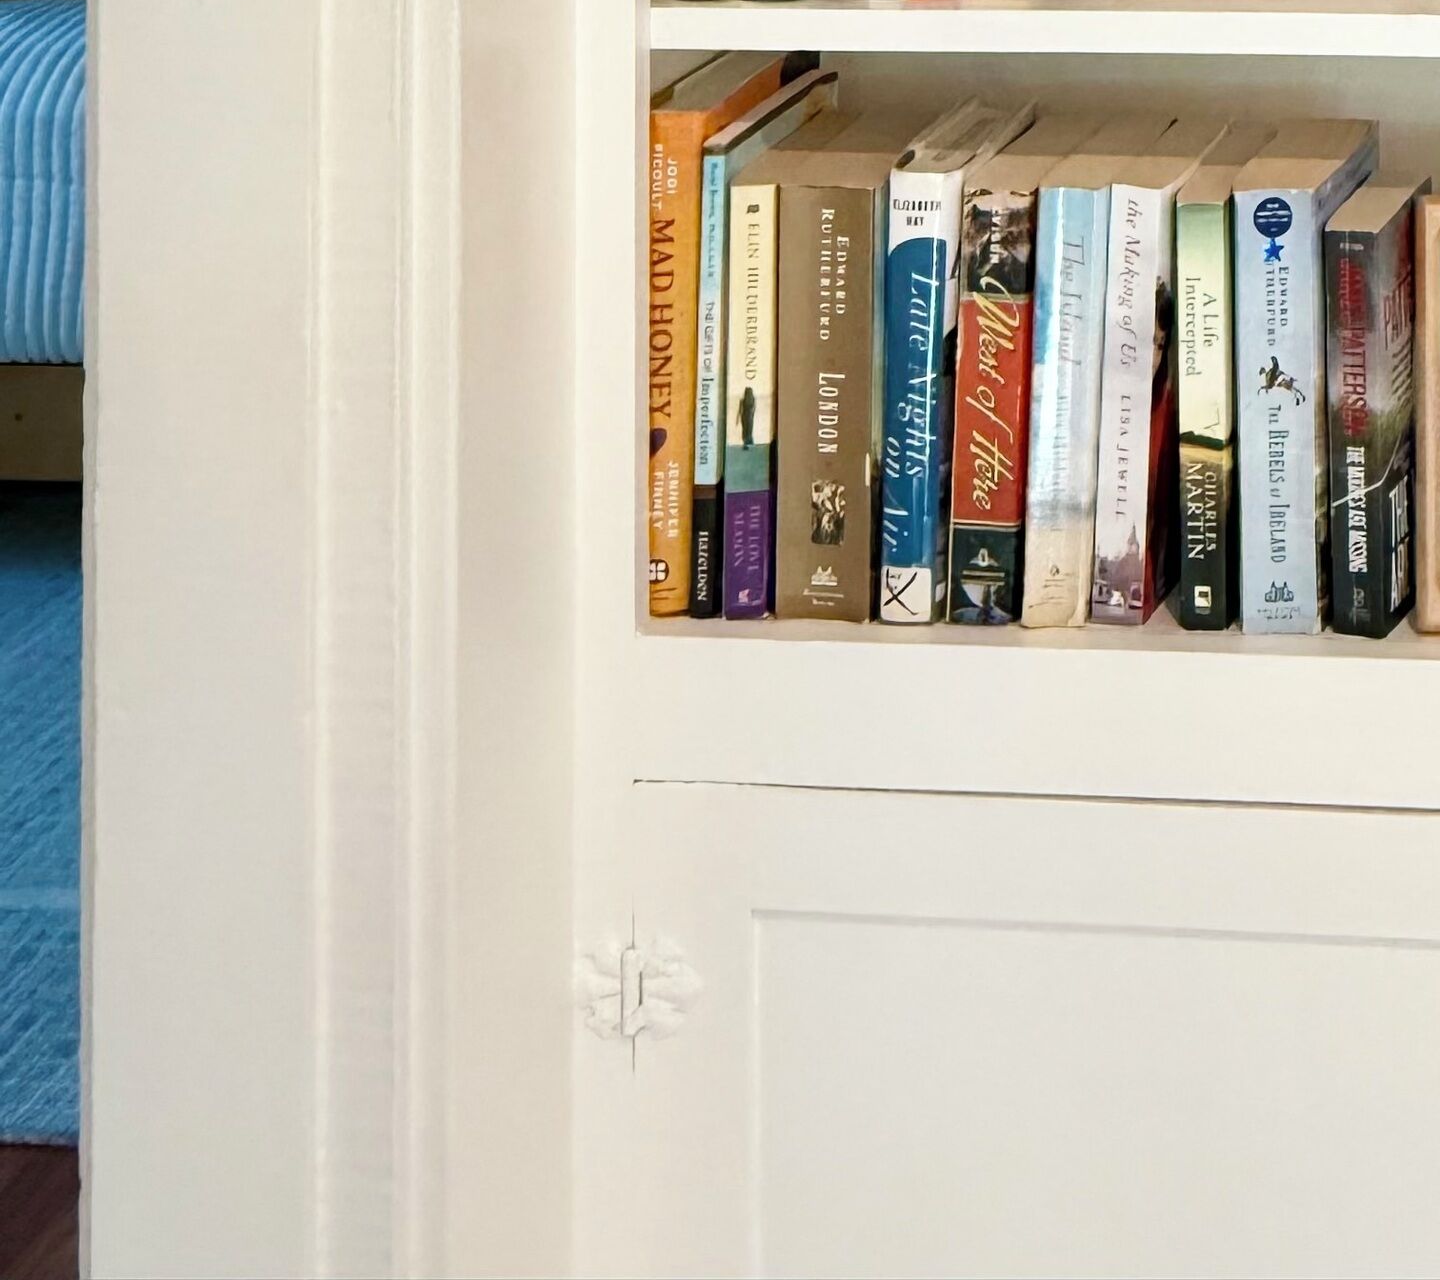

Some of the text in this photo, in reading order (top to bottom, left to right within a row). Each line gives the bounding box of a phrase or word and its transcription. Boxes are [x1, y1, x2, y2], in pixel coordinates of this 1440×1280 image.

[748, 222, 761, 261] ELIN
[650, 218, 676, 418] MAD HONEY
[1184, 276, 1202, 376] Intercepted
[1203, 292, 1219, 347] A Life
[818, 372, 845, 454] LONDON
[897, 271, 938, 478] Late Nights
[967, 278, 1019, 510] West of Here
[653, 471, 666, 530] FINNEY
[882, 436, 908, 551] on Air
[1187, 460, 1204, 560] MARTIN
